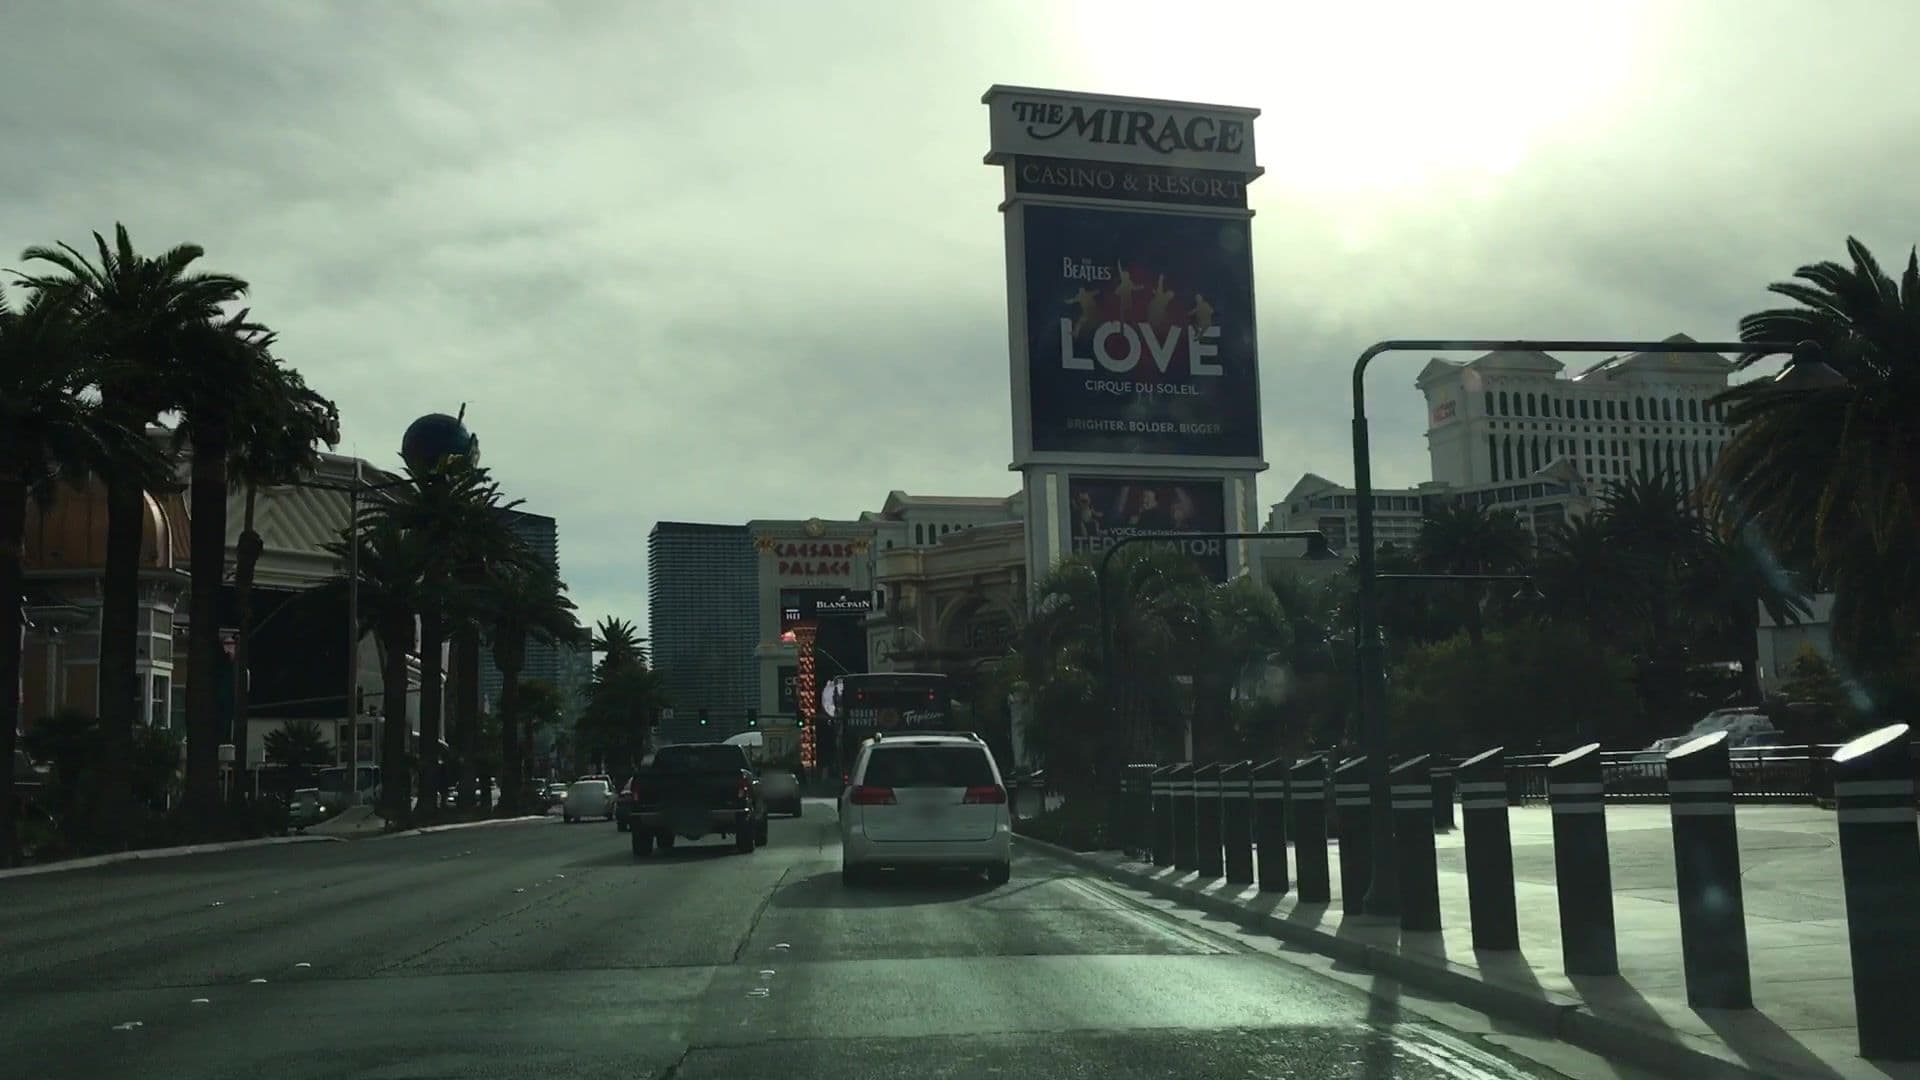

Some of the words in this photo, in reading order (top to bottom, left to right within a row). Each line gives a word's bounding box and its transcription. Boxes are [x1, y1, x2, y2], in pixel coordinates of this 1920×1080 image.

[1011, 101, 1063, 124] THE
[1026, 107, 1244, 154] MIRAGE
[1023, 164, 1114, 190] CASINO
[1123, 175, 1138, 192] &
[1148, 175, 1244, 199] RESORT
[1060, 317, 1223, 376] LOVE
[1084, 380, 1132, 395] CIRQUE
[1135, 381, 1153, 393] DU
[1156, 383, 1199, 395] SOLEIL
[1129, 420, 1177, 433] BOLDER.
[775, 543, 854, 558] CAESARS
[778, 560, 850, 576] PALACE
[816, 600, 871, 609] BLANCPAIN
